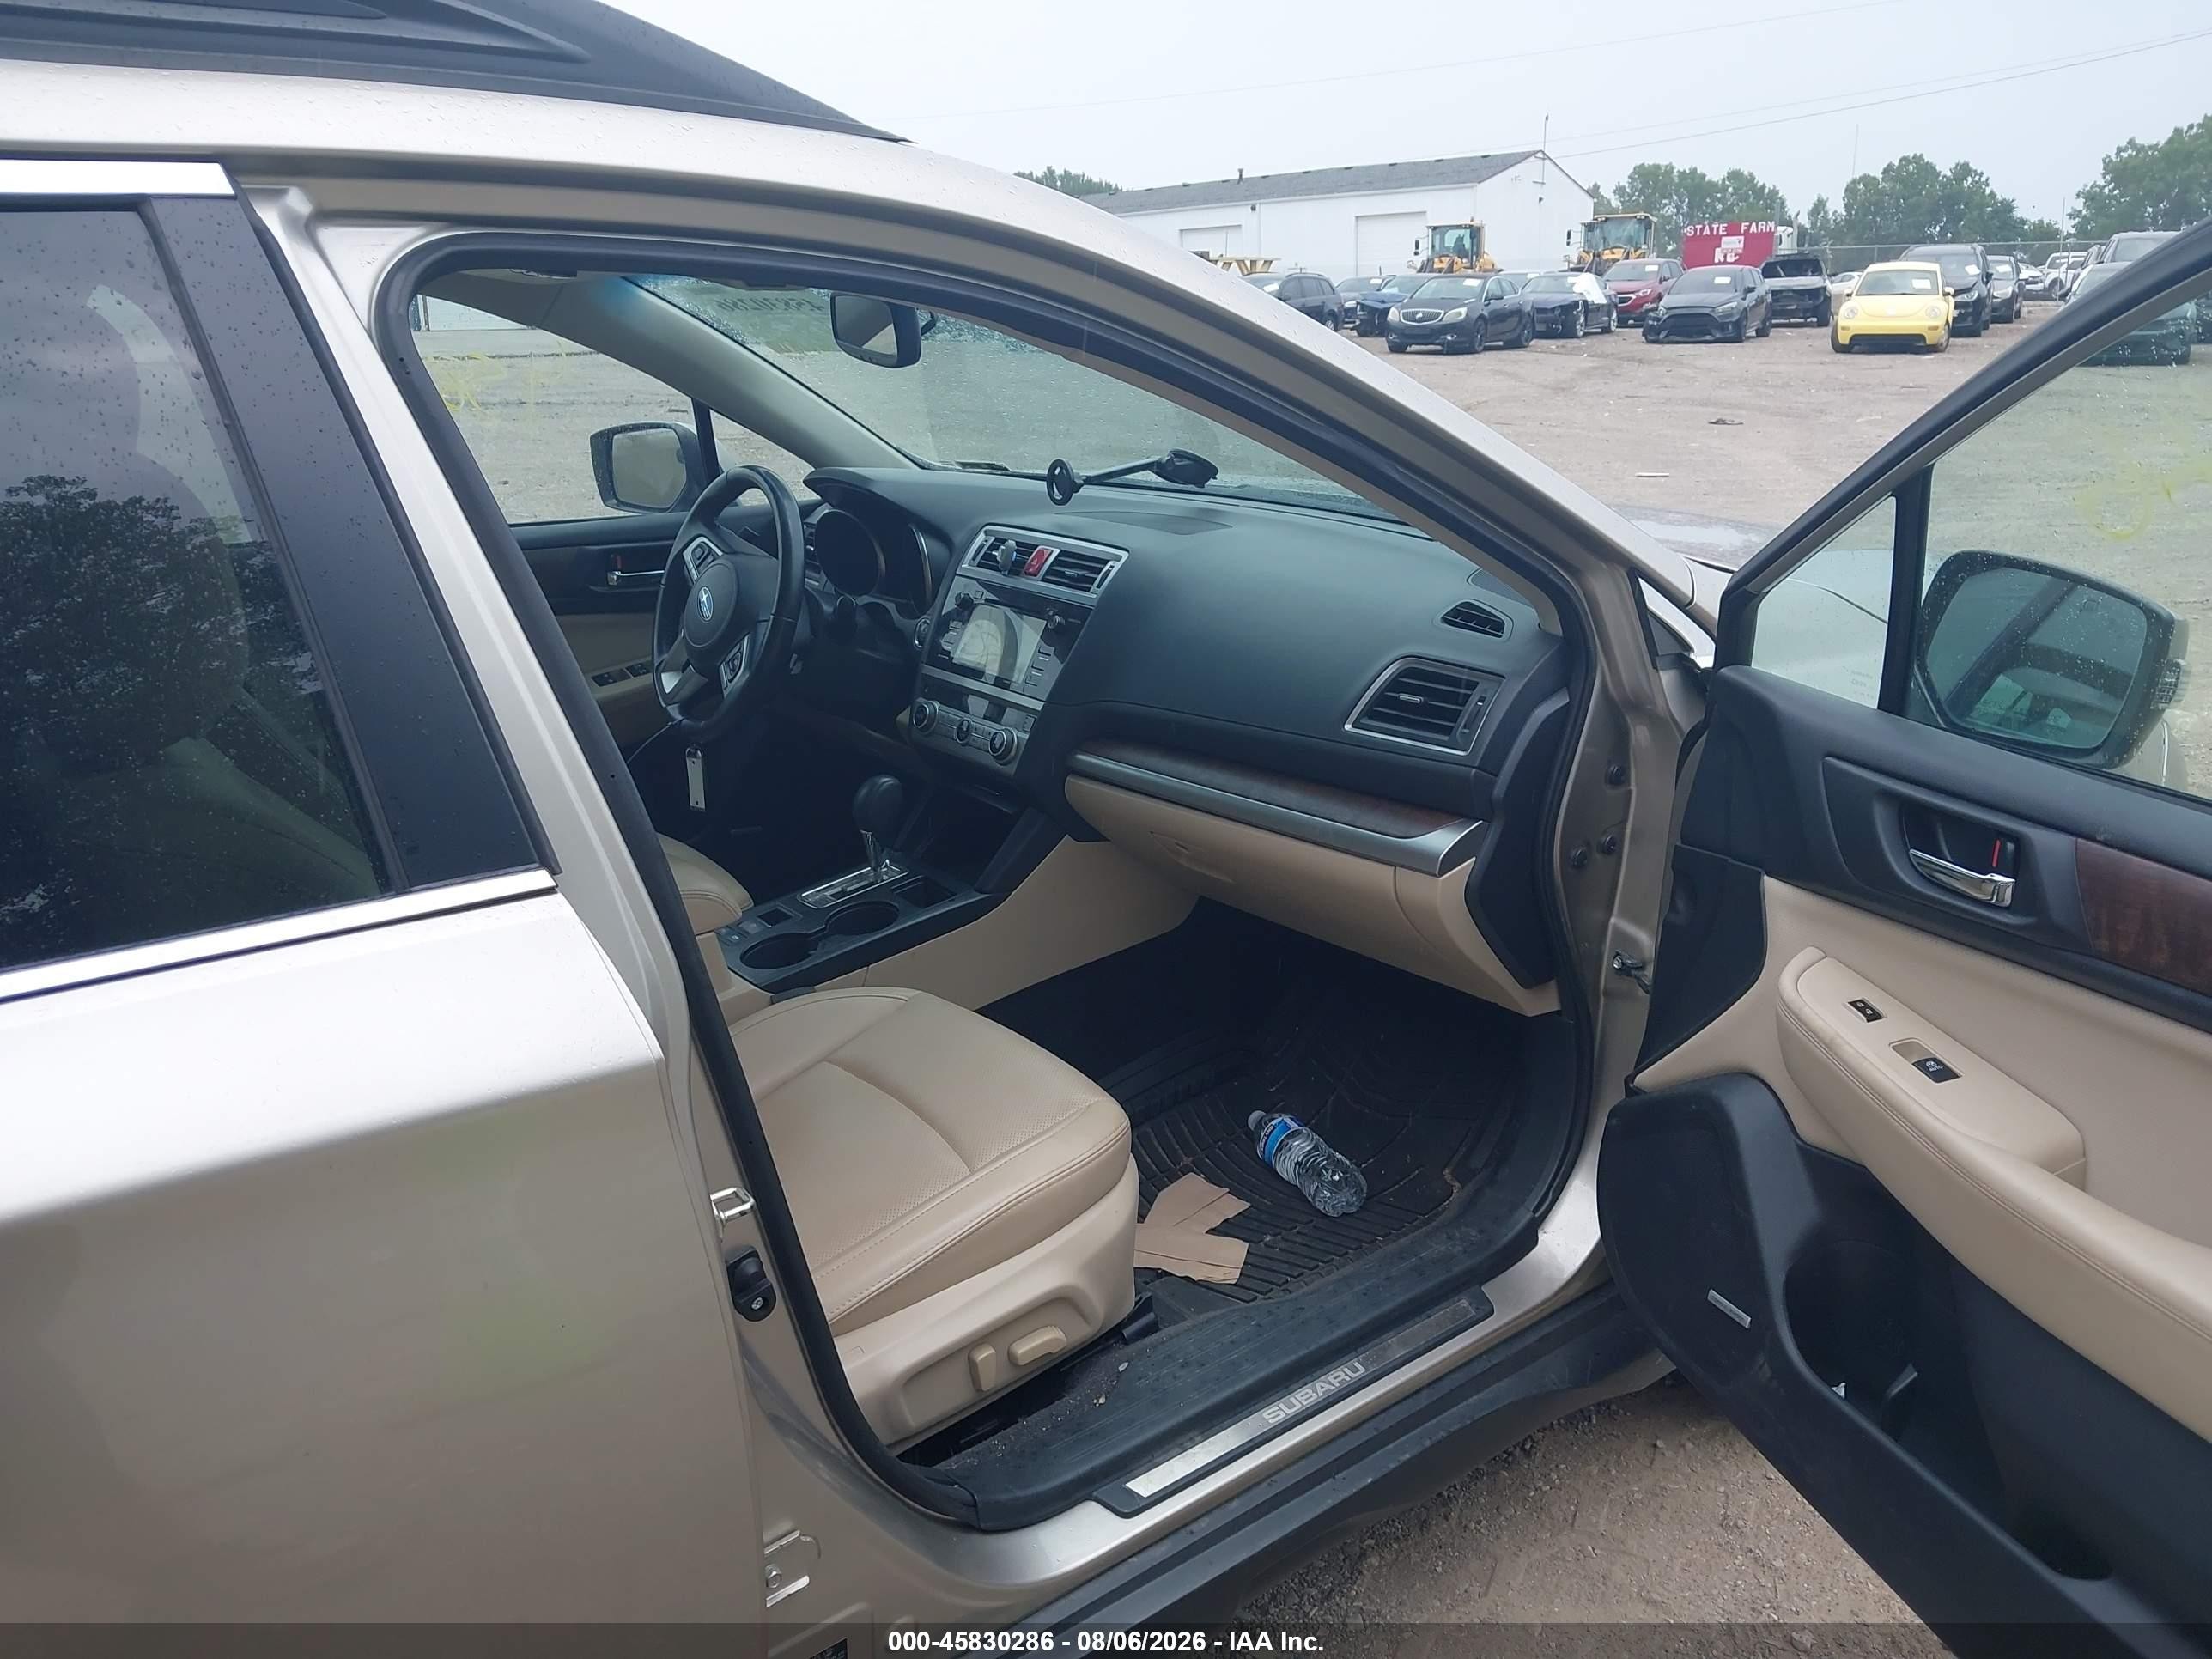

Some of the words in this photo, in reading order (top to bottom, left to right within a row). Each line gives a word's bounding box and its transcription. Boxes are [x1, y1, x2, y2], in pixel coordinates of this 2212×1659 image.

[1686, 223, 1728, 236] STATE
[1741, 221, 1775, 234] FARM
[1261, 1361, 1366, 1424] SUBARU
